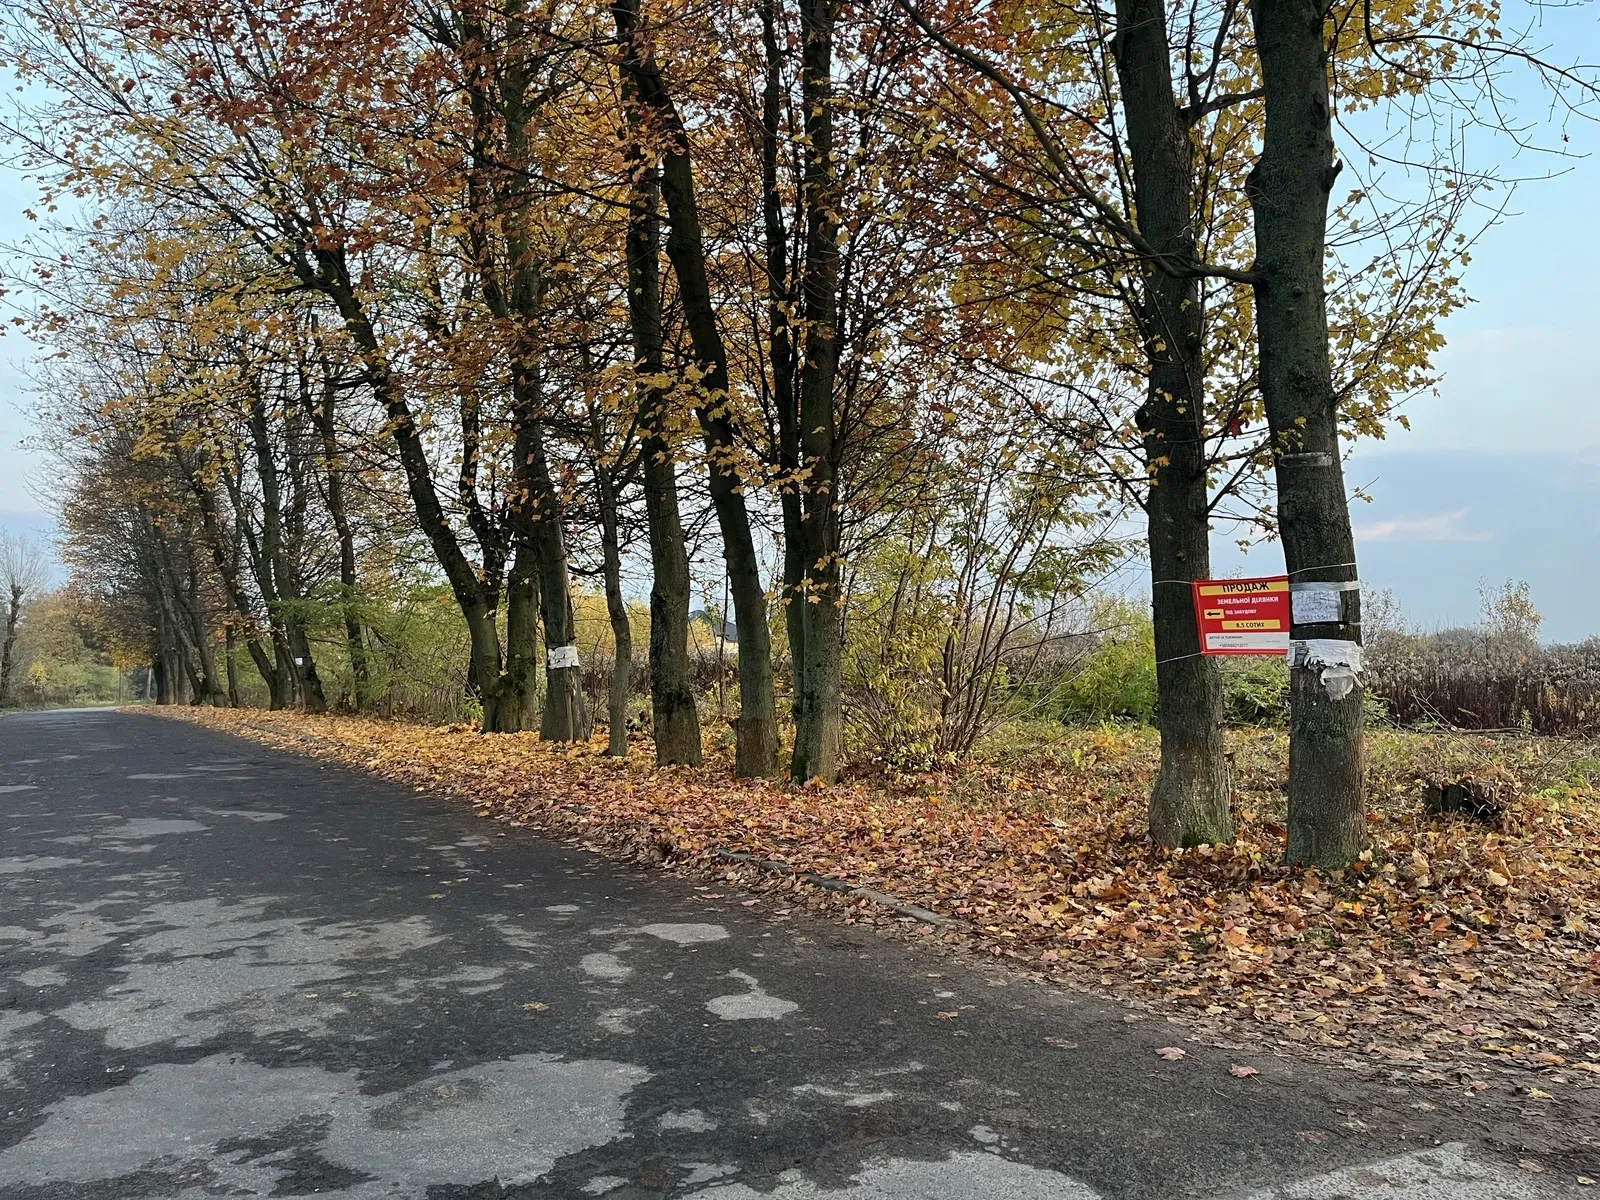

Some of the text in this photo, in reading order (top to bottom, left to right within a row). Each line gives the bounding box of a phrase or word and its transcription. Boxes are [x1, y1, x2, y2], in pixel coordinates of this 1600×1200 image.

[1222, 582, 1269, 593] ПРОДАЖ
[1217, 596, 1279, 605] ЗЕМЕЛЬНОЇ ДІЛЯНКИ
